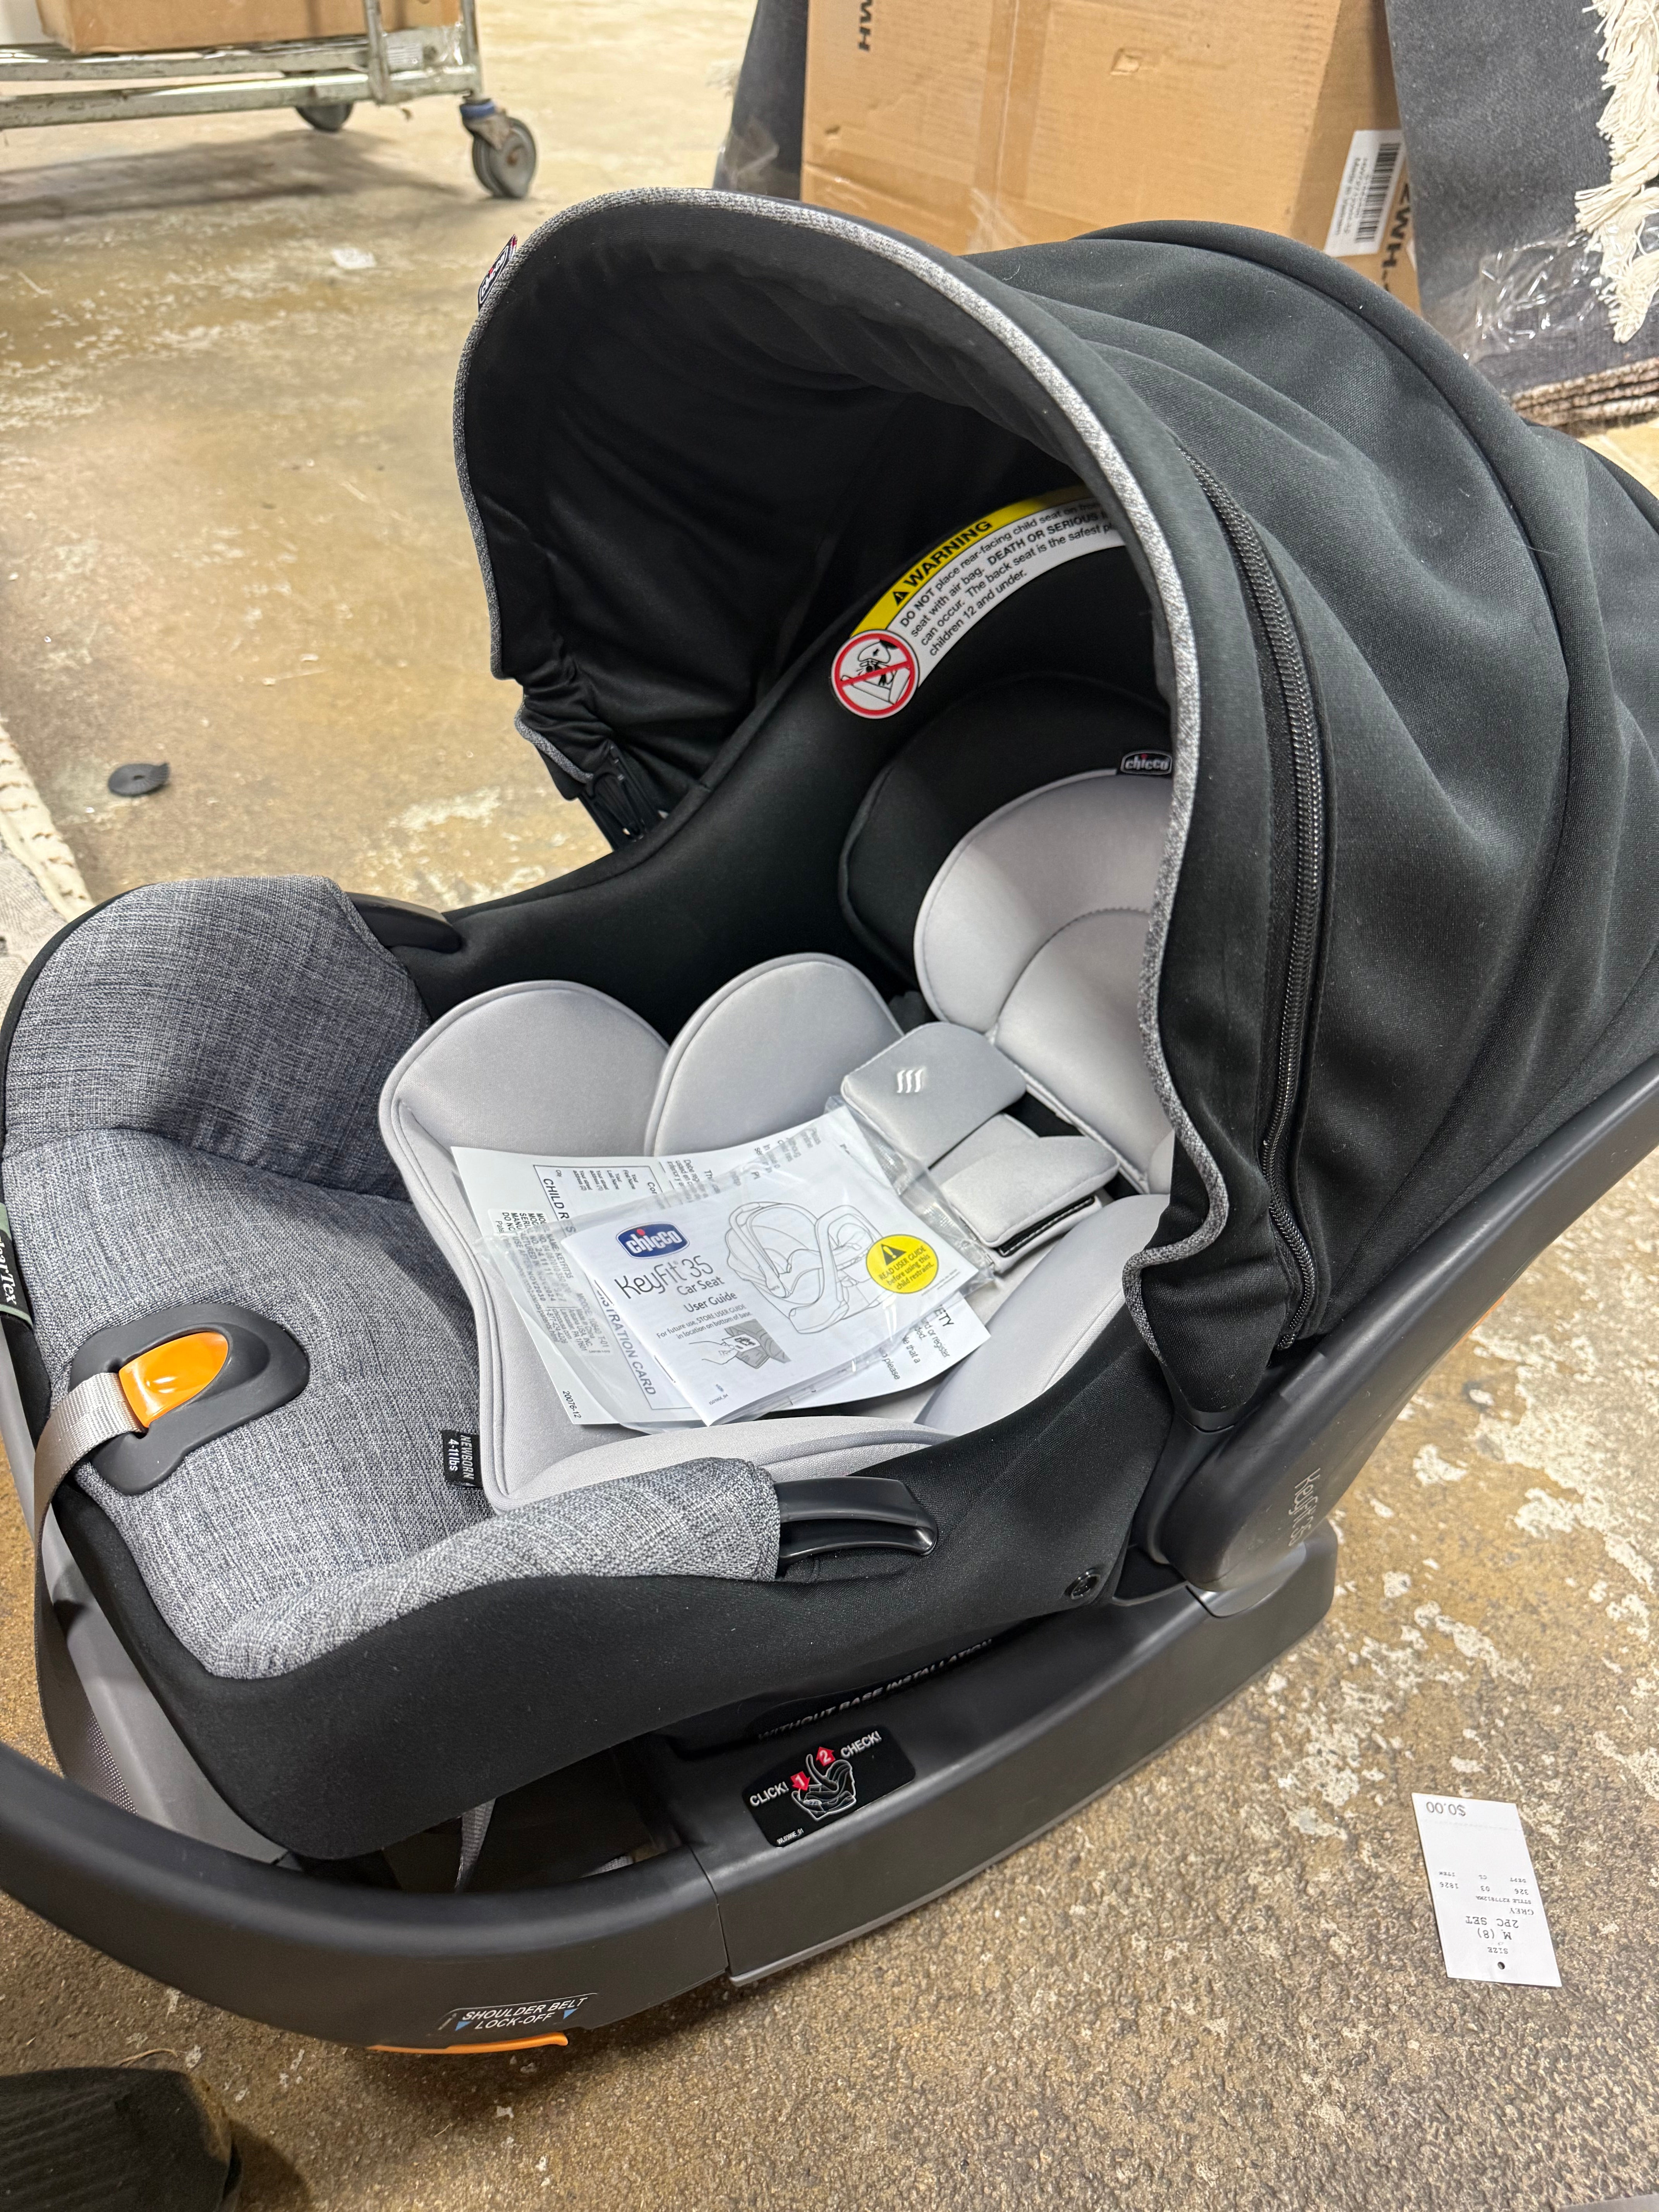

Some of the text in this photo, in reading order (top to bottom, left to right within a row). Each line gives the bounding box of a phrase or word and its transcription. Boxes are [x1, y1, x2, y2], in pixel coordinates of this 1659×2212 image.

[481, 252, 506, 297] chicco
[903, 521, 993, 587] WARNING
[900, 610, 916, 627] DO
[914, 588, 936, 610] NOT
[935, 566, 960, 592] place
[960, 532, 1012, 569] rear-facing
[1013, 519, 1037, 534] child
[1039, 510, 1061, 523] seat
[911, 512, 1099, 637] seat with air bag. DEATH OR SERIOUS
[921, 627, 938, 646] can
[937, 600, 966, 627] occur.
[964, 581, 987, 598] The
[984, 562, 1013, 583] back
[1012, 548, 1037, 566] seat
[1036, 544, 1048, 553] is
[1048, 536, 1066, 548] the
[1068, 525, 1101, 541] safest
[929, 569, 1027, 656] children 12 and under.
[1124, 754, 1169, 772] chicco
[626, 1229, 682, 1254] chicco
[501, 1212, 512, 1221] DO
[512, 1237, 524, 1248] USE
[526, 1271, 547, 1301] NOV2030
[555, 1253, 574, 1278] KEYFIT35
[682, 1255, 713, 1278] 35
[878, 1246, 926, 1280] READ USER GUIDE
[886, 1254, 930, 1286] before using this
[896, 1279, 910, 1290] child
[910, 1262, 934, 1281] restraint.
[543, 1178, 658, 1395] CHILD CARD
[677, 1276, 725, 1295] Car Seat
[683, 1292, 737, 1312] User Guide
[657, 1330, 667, 1339] For
[667, 1324, 686, 1333] future
[696, 1313, 714, 1324] STORE
[715, 1309, 728, 1318] USER
[729, 1304, 747, 1313] GUIDE
[682, 1325, 706, 1337] location
[714, 1317, 736, 1326] bottom
[906, 1344, 916, 1358] that
[933, 1335, 950, 1358] register
[882, 1357, 900, 1380] please
[563, 1391, 581, 1418] 20076-12
[460, 1435, 474, 1479] NEWBORN
[820, 1750, 830, 1764] 2
[840, 1730, 883, 1759] CHECK!
[795, 1774, 804, 1786] 1
[750, 1781, 789, 1807] CLICK!
[1426, 1802, 1466, 1817] $0.00
[1466, 1916, 1518, 1928] 2PC SET
[1477, 1928, 1494, 1939] (8)
[462, 1997, 588, 2021] SHOULDER BELT
[475, 2013, 556, 2030] LOCK-OFF
